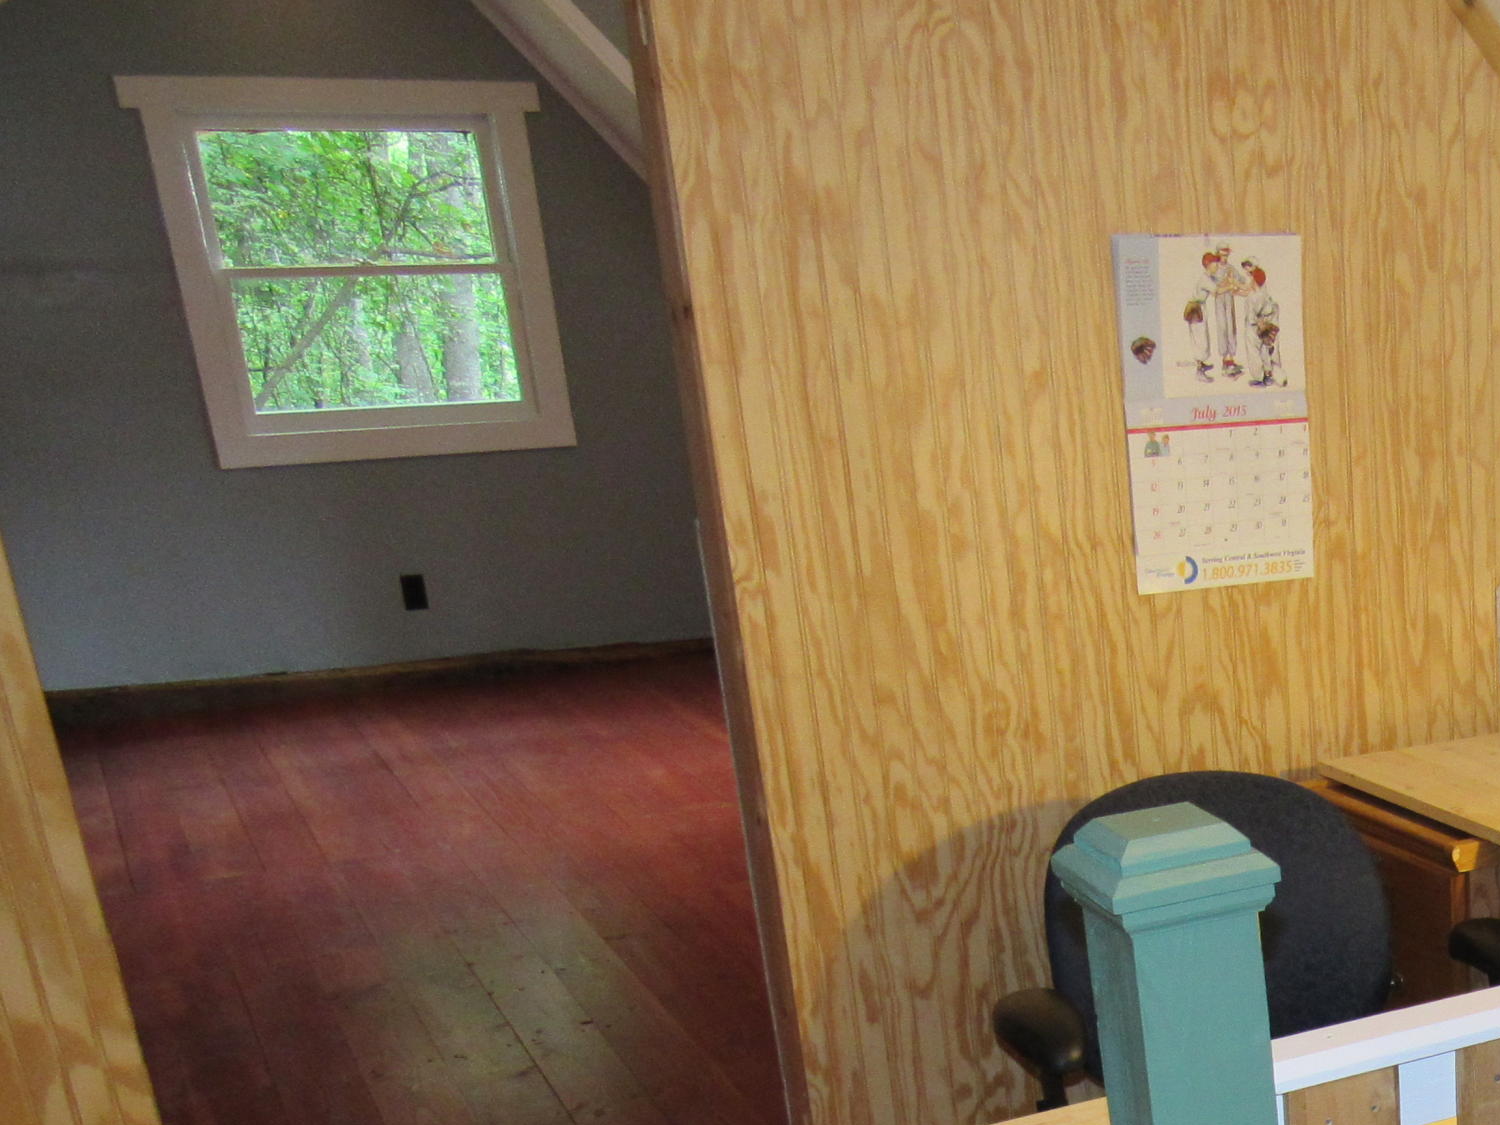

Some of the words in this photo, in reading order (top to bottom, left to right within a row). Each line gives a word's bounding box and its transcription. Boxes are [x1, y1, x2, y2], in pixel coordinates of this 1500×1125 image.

[1191, 404, 1217, 421] July
[1222, 404, 1247, 417] 2015
[1282, 548, 1306, 557] Virginia
